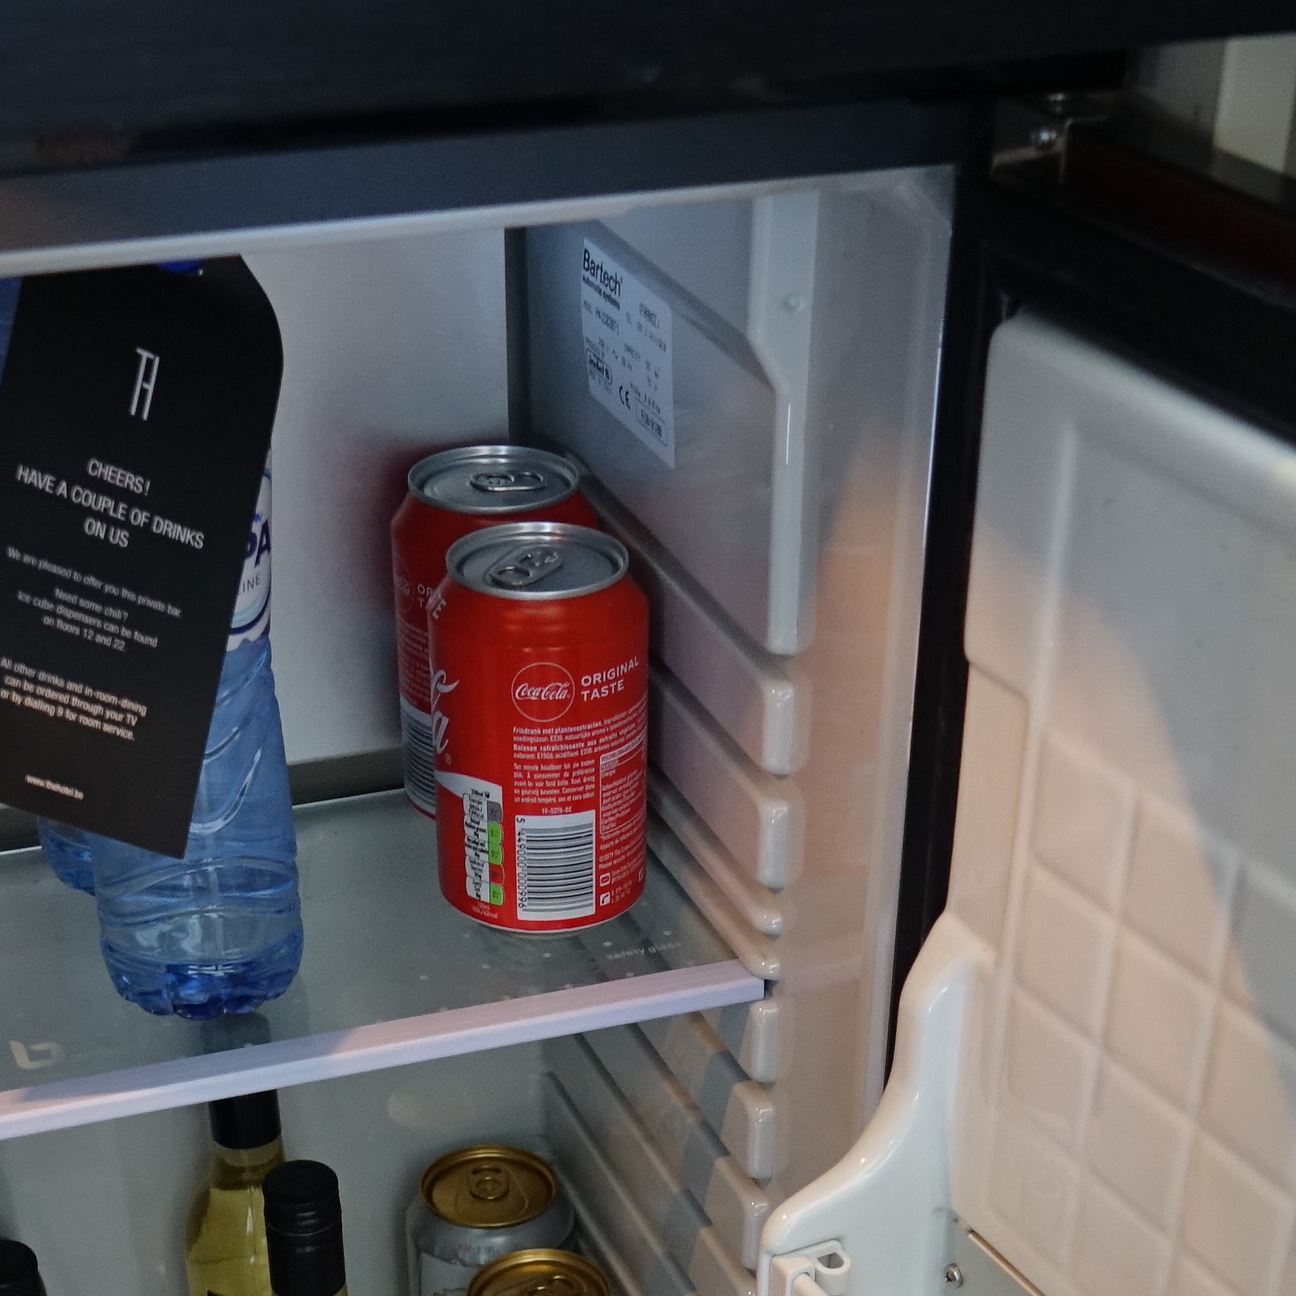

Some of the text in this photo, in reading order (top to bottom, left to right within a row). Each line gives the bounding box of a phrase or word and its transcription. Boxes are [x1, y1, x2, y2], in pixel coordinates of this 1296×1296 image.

[582, 248, 622, 297] Bartech
[16, 463, 205, 550] HAVE A COUPLE OF DRINKS
[84, 516, 130, 548] ON US
[7, 546, 22, 561] We
[22, 552, 38, 566] are
[38, 558, 72, 580] pleased
[73, 569, 83, 582] to
[83, 573, 104, 590] offer
[103, 582, 120, 597] you
[121, 587, 137, 602] this
[137, 594, 166, 613] private
[17, 590, 159, 649] Ice cube dispensers can be found
[54, 586, 129, 623] Need some chill?
[43, 615, 55, 627] on
[56, 618, 81, 636] floors
[82, 627, 95, 641] 12
[95, 632, 112, 647] and
[0, 657, 12, 670] All
[13, 661, 37, 678] other
[37, 670, 66, 688] drinks
[66, 680, 84, 694] and
[581, 656, 640, 687] ORIGINAL
[581, 679, 625, 702] TASTE
[0, 688, 136, 742] or by dialling 9 for room service.
[4, 674, 138, 727] can be ordered through your TV
